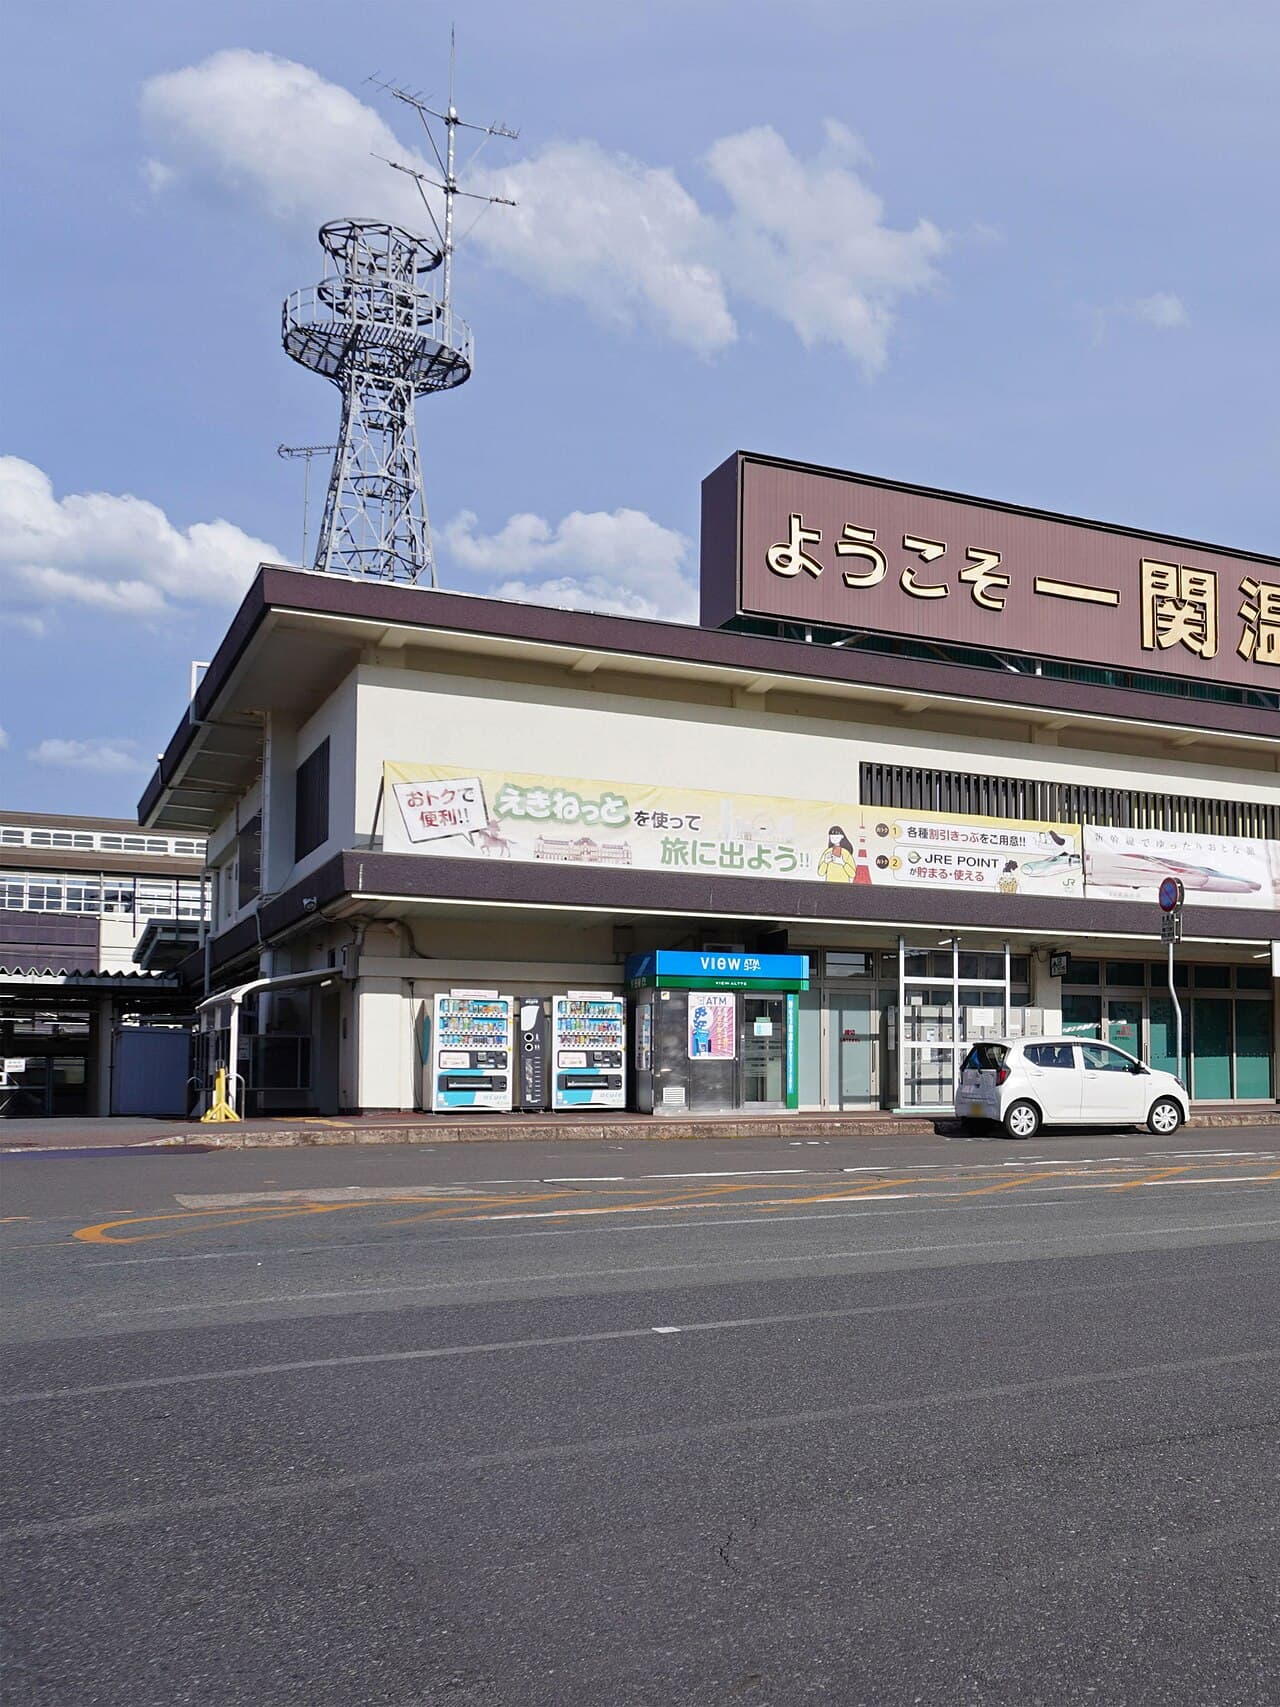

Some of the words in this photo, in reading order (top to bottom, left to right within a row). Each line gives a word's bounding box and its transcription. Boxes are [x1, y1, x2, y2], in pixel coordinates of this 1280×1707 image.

[406, 787, 475, 808] おトクで
[498, 786, 628, 825] えきねっと
[418, 808, 470, 828] 便利!!
[634, 810, 701, 831] を使って
[660, 836, 810, 873] 旅に出よう!!
[925, 853, 953, 865] JRE
[957, 855, 999, 869] POINT
[1062, 878, 1076, 887] JR
[706, 996, 727, 1005] ATM
